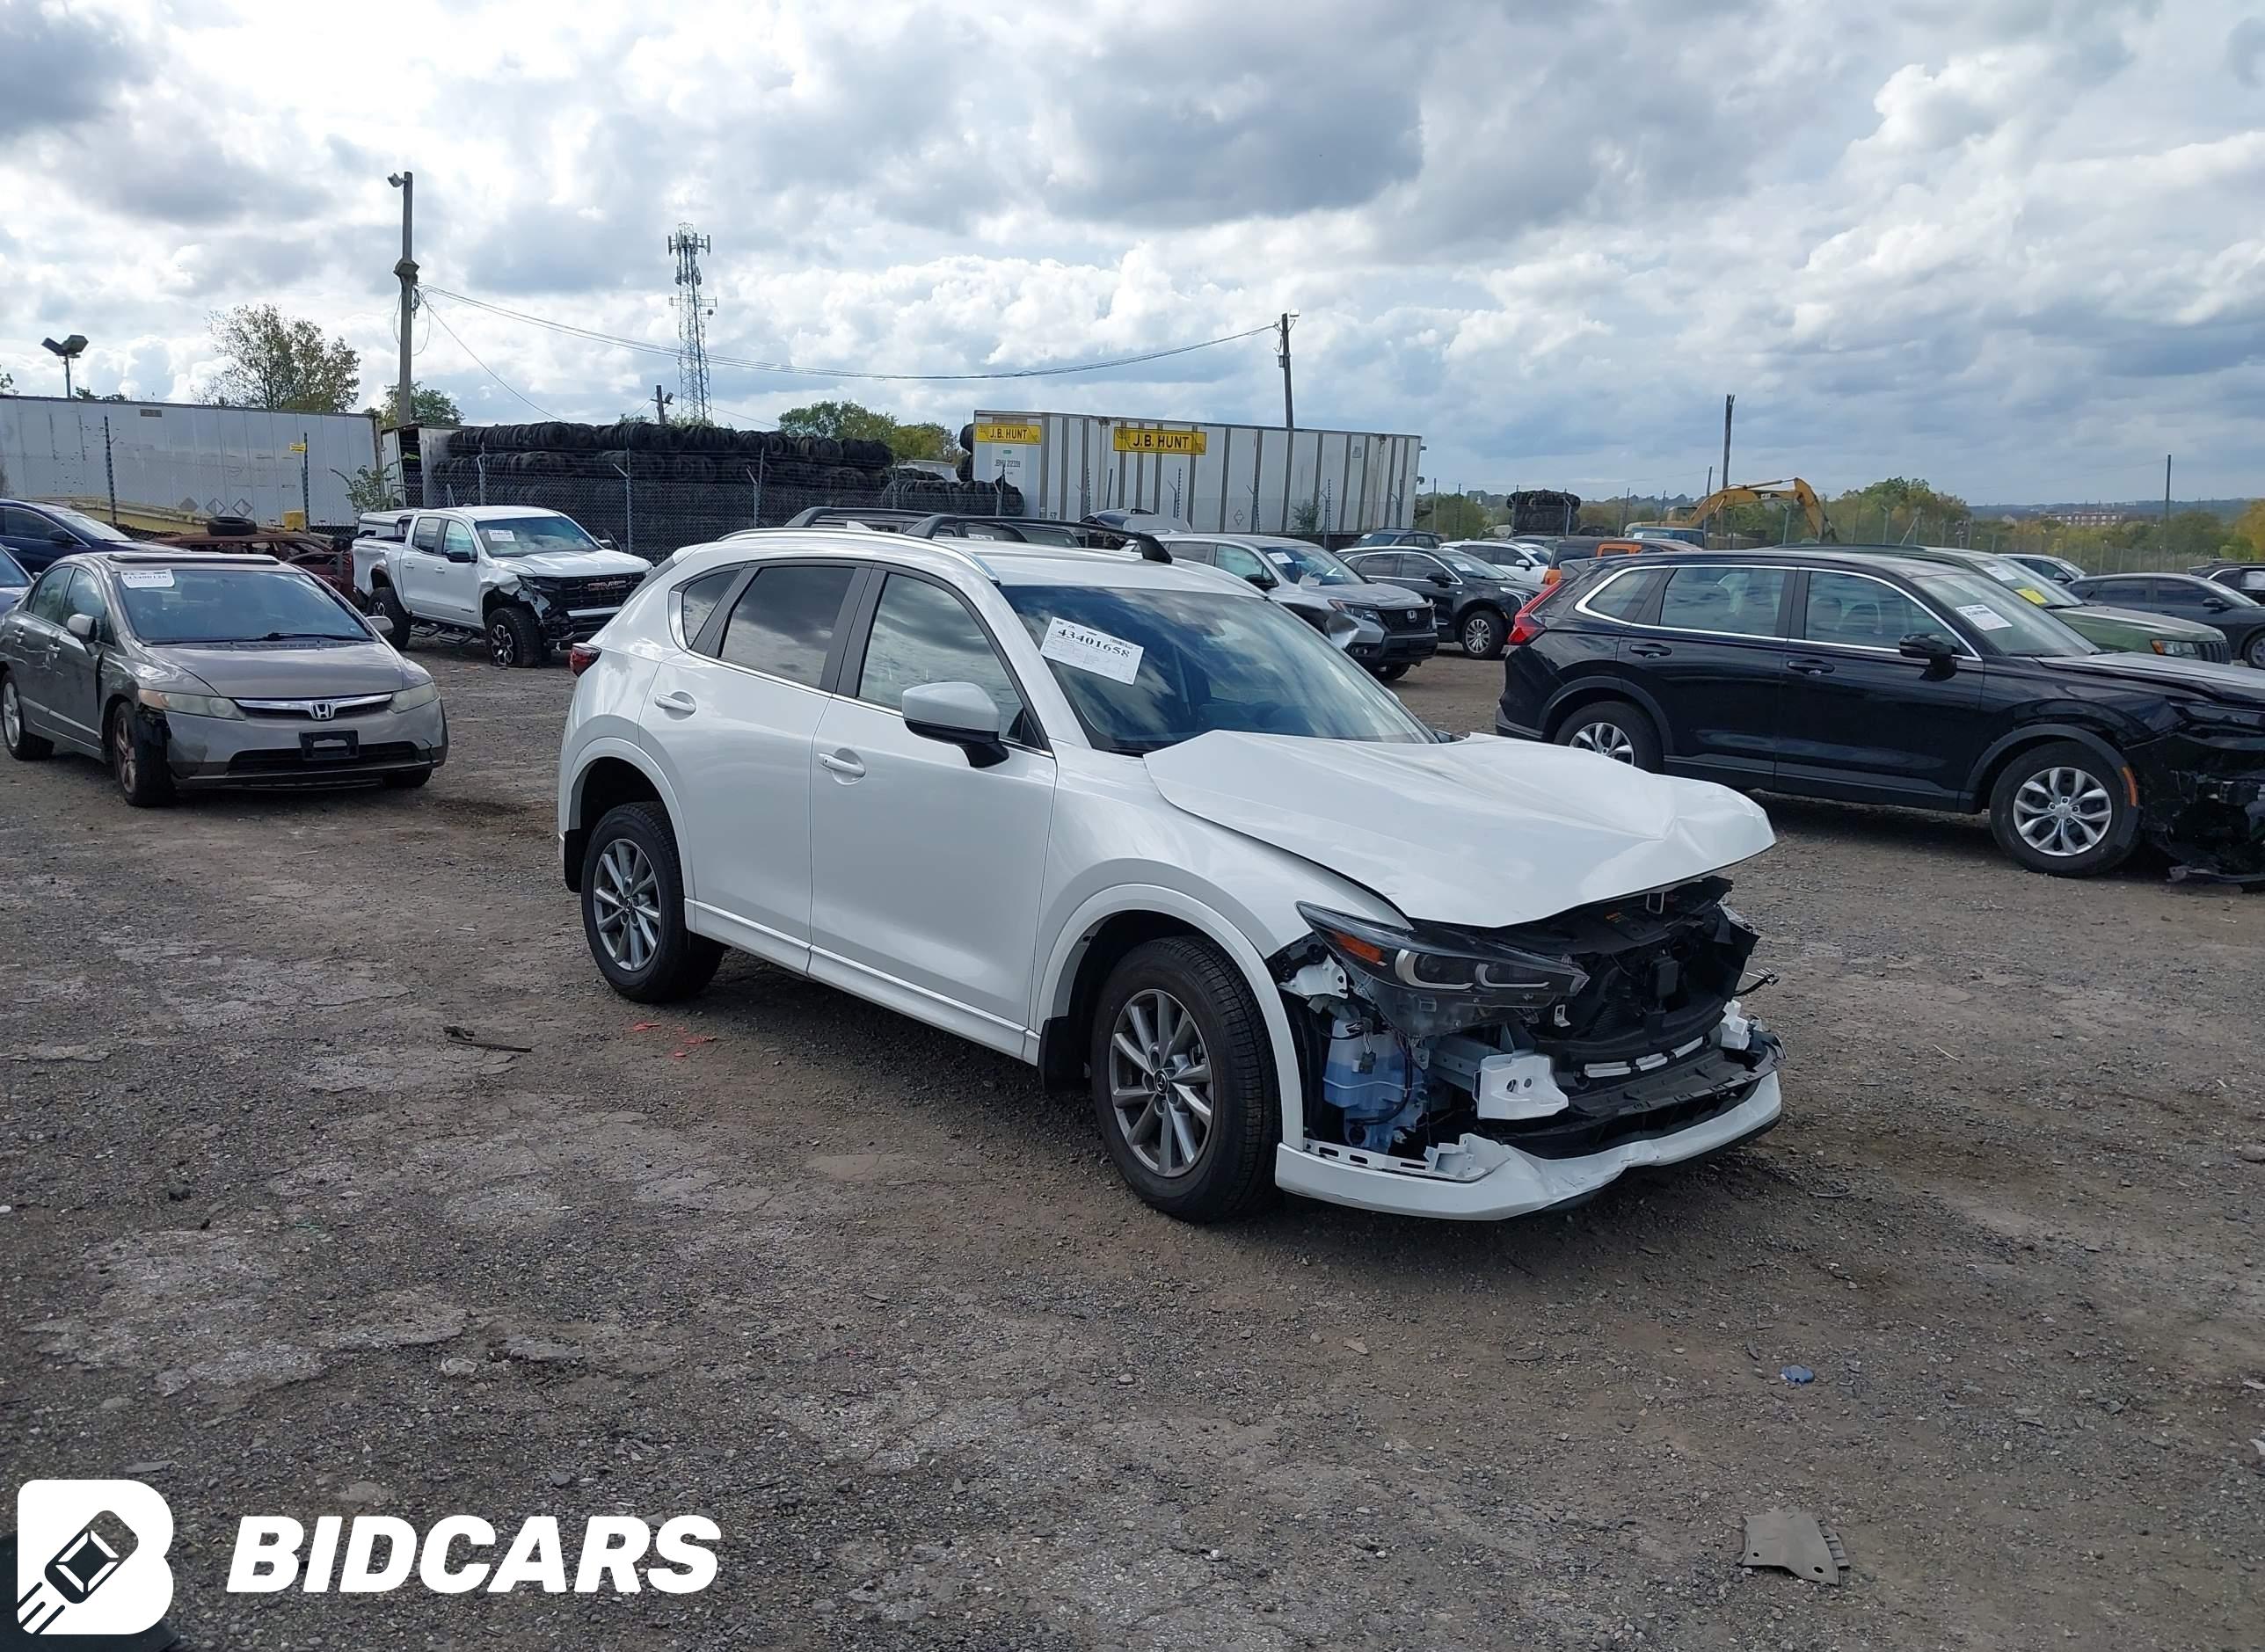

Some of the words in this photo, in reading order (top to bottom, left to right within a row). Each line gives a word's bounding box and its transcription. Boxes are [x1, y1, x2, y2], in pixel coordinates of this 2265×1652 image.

[990, 428, 1004, 439] J.B.
[1005, 429, 1028, 440] HUNT
[1132, 433, 1154, 448] J.B.
[1157, 434, 1189, 449] HUNT
[1058, 629, 1131, 658] 43401658
